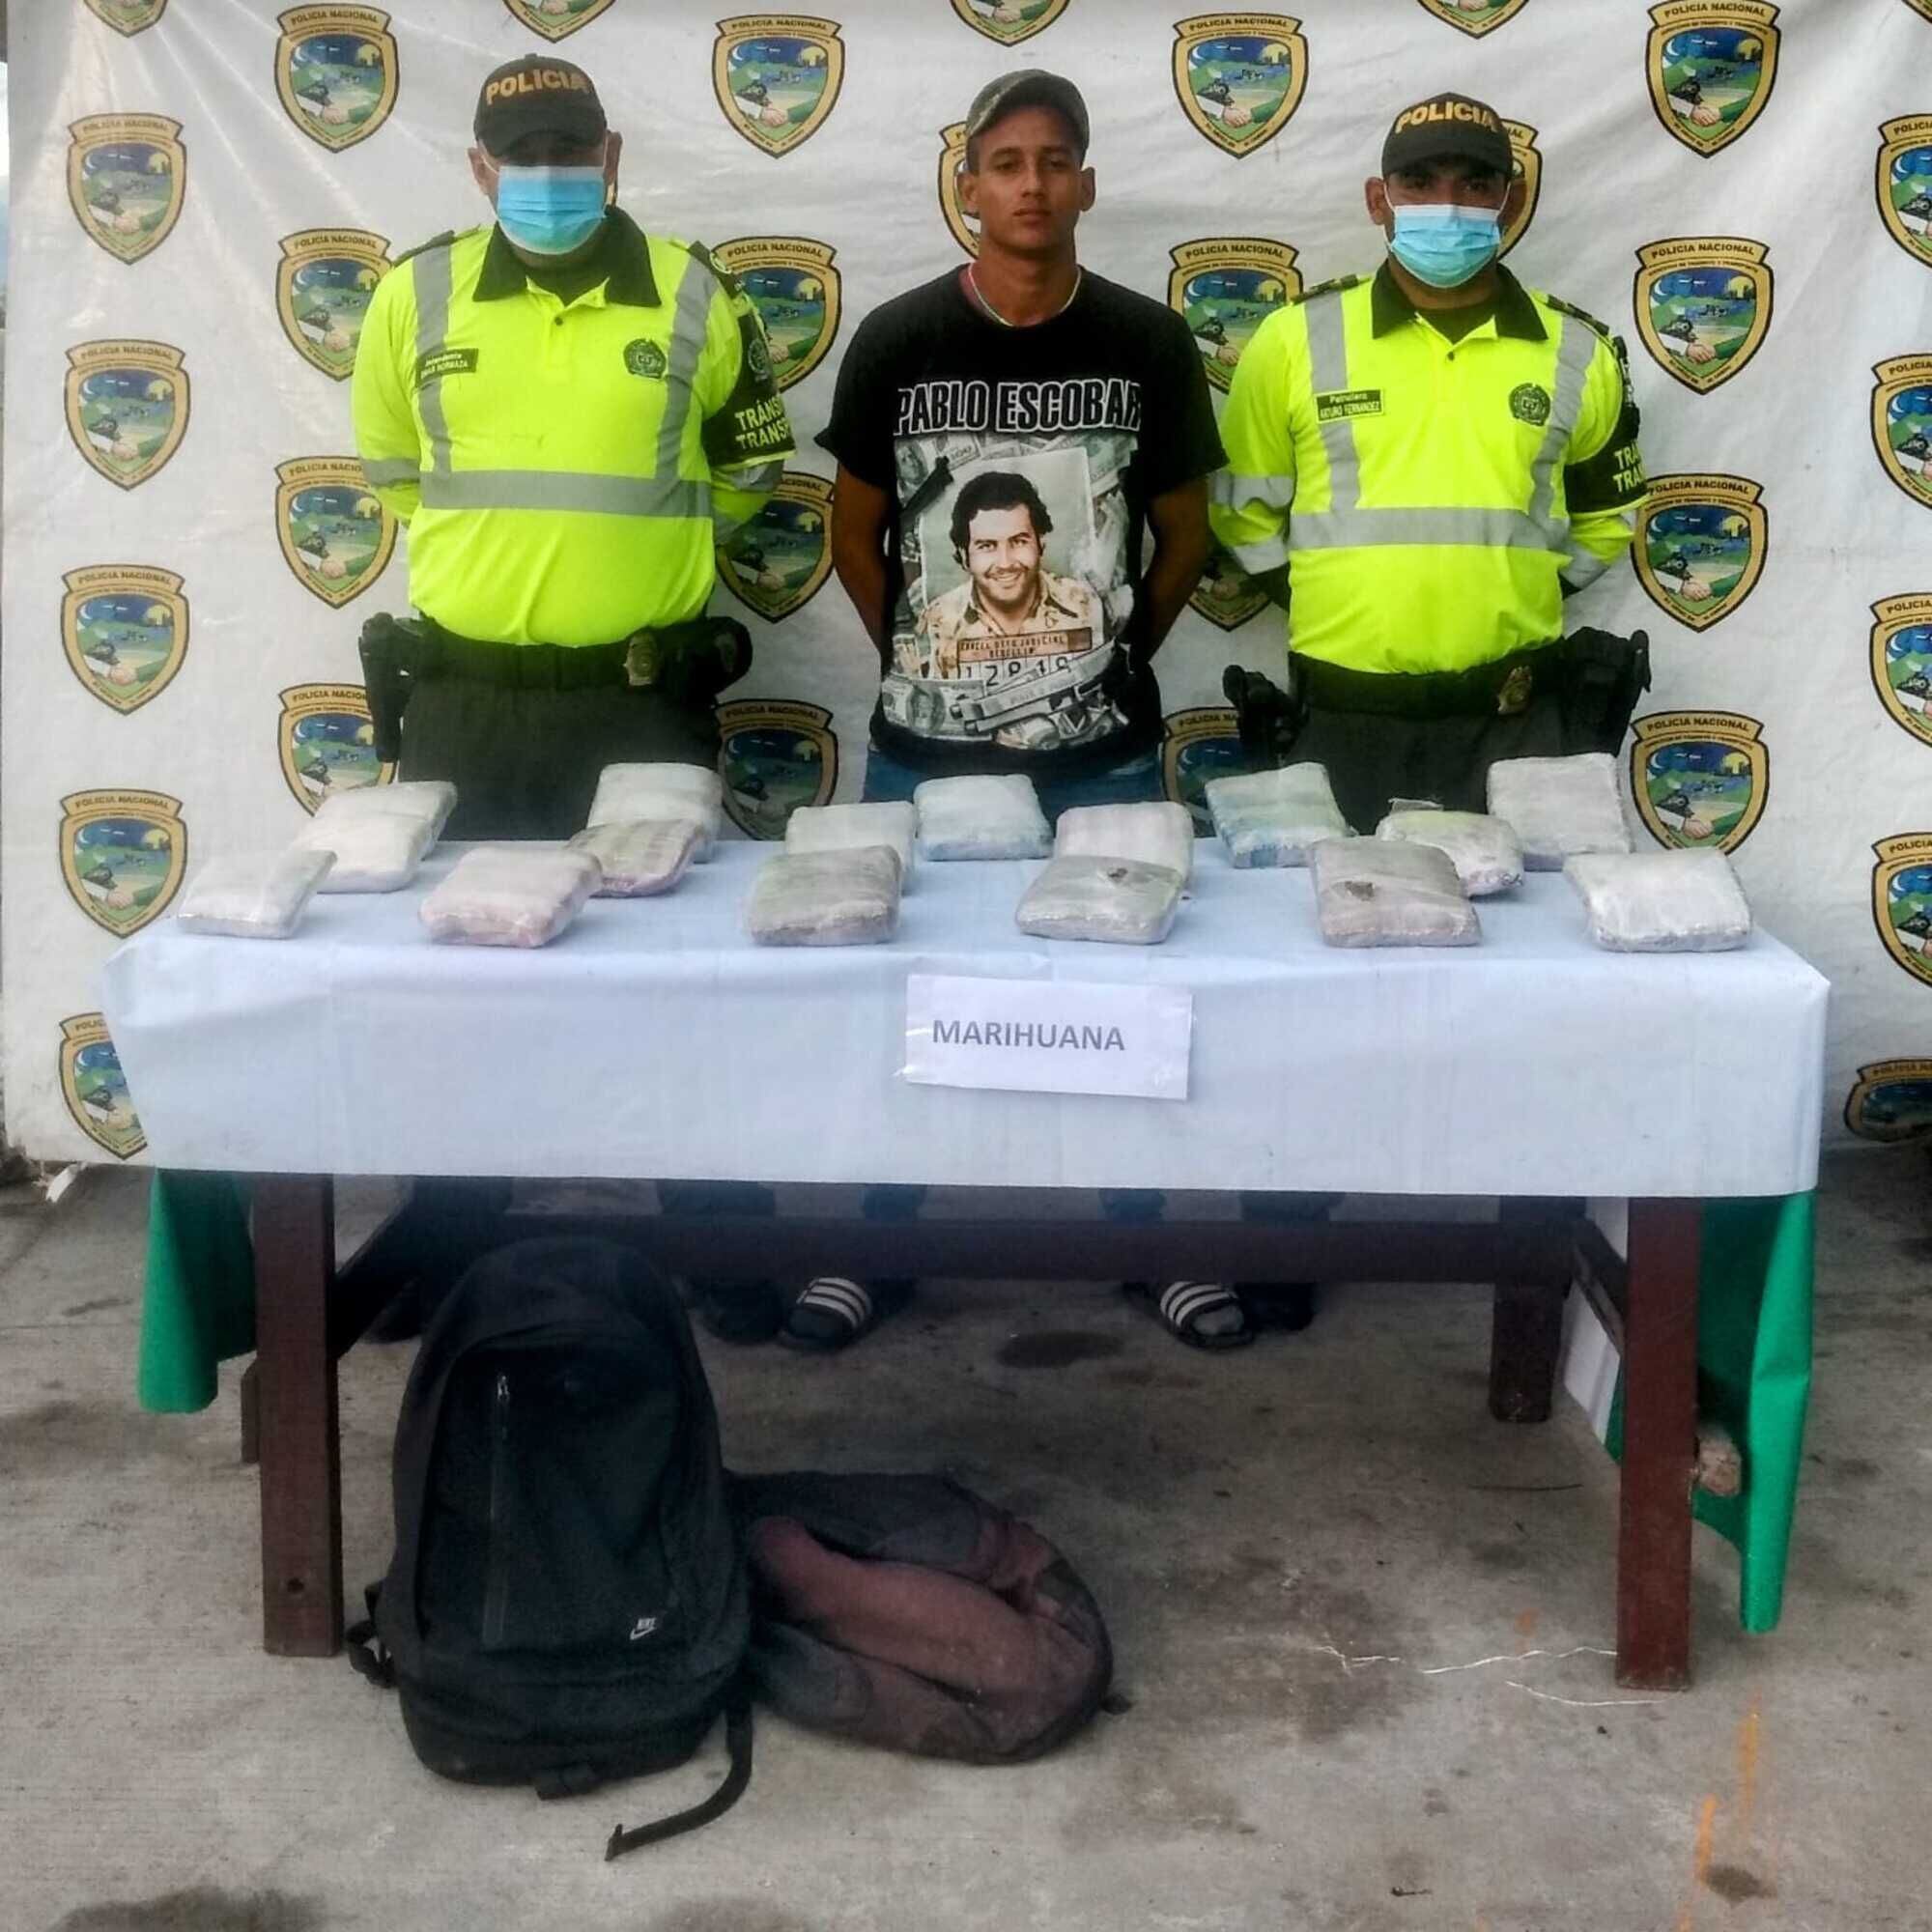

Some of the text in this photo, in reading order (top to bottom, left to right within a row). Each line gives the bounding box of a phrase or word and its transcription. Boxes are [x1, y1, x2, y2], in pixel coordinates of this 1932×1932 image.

[292, 10, 379, 24] POLICIA NACIONAL
[1664, 3, 1766, 17] POLICIA NACIONAL
[1188, 18, 1288, 31] POLICIA NACIONAL
[486, 70, 590, 105] POLICIA
[1395, 101, 1498, 134] POLICIA
[295, 237, 378, 249] POLICIA NACIONAL
[727, 243, 823, 257] POLICIA NACIONAL
[1185, 244, 1284, 259] POLICIA NACIONAL
[1652, 243, 1754, 259] POLICIA NACIONAL
[735, 397, 781, 431] TRÁNS
[894, 378, 1141, 436] PABLO ESCOBAR
[290, 463, 362, 476] POLICIA NACIO
[1649, 481, 1748, 495] POLICIA NACIONAL
[1888, 601, 1932, 613] POLICIA
[294, 690, 327, 701] POLICIA
[1646, 718, 1748, 731] POLICIA NACIONAL
[932, 1019, 1125, 1051] MARIHUANA
